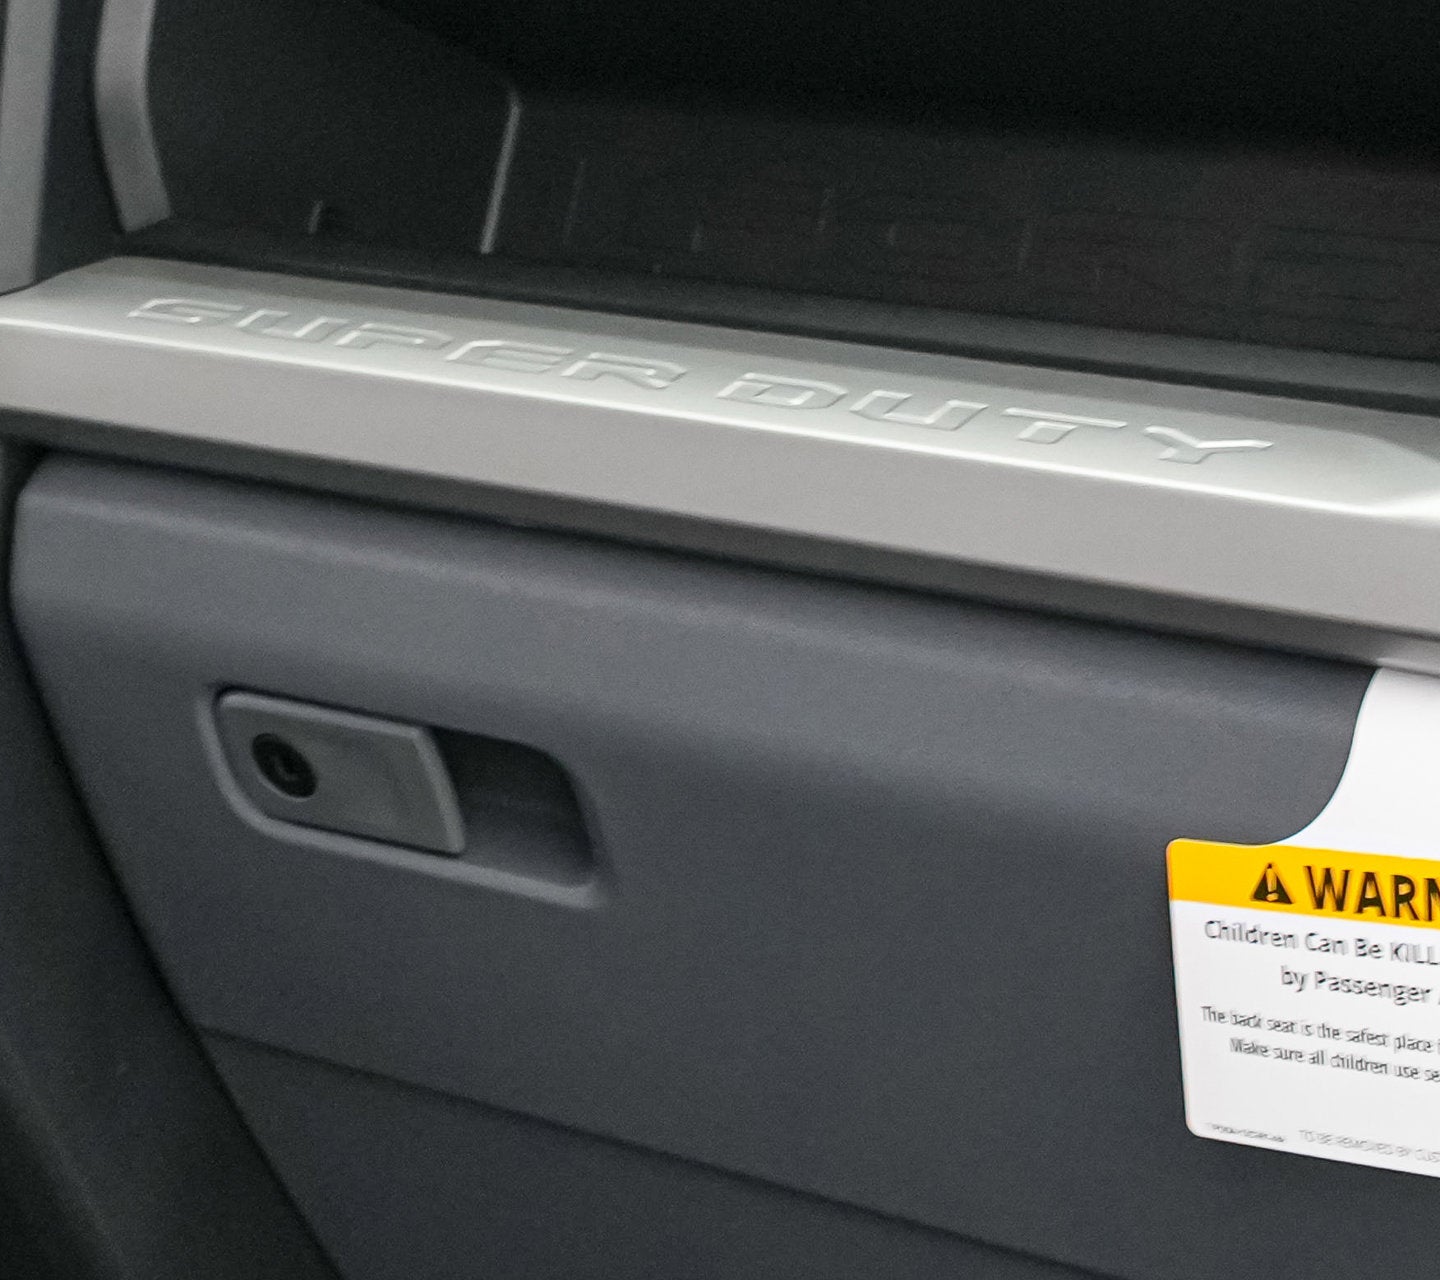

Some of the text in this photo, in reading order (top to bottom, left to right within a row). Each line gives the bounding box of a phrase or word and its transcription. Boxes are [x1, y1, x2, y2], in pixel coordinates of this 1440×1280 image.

[126, 296, 1276, 464] SUPER DUTY
[1204, 919, 1297, 950] Children
[1305, 932, 1347, 956] Can
[1355, 938, 1383, 959] Be
[1281, 965, 1307, 993] by
[1314, 970, 1431, 1007] Passenger
[1201, 1005, 1227, 1024] The
[1231, 1010, 1262, 1029] back
[1267, 1017, 1296, 1034] seat
[1302, 1020, 1314, 1037] is
[1318, 1022, 1342, 1041] the
[1345, 1026, 1388, 1047] safest
[1394, 1034, 1432, 1055] place
[1229, 1037, 1270, 1059] Make
[1273, 1047, 1304, 1064] sure
[1308, 1049, 1325, 1066] all
[1330, 1052, 1388, 1076] children
[1394, 1064, 1420, 1081] use
